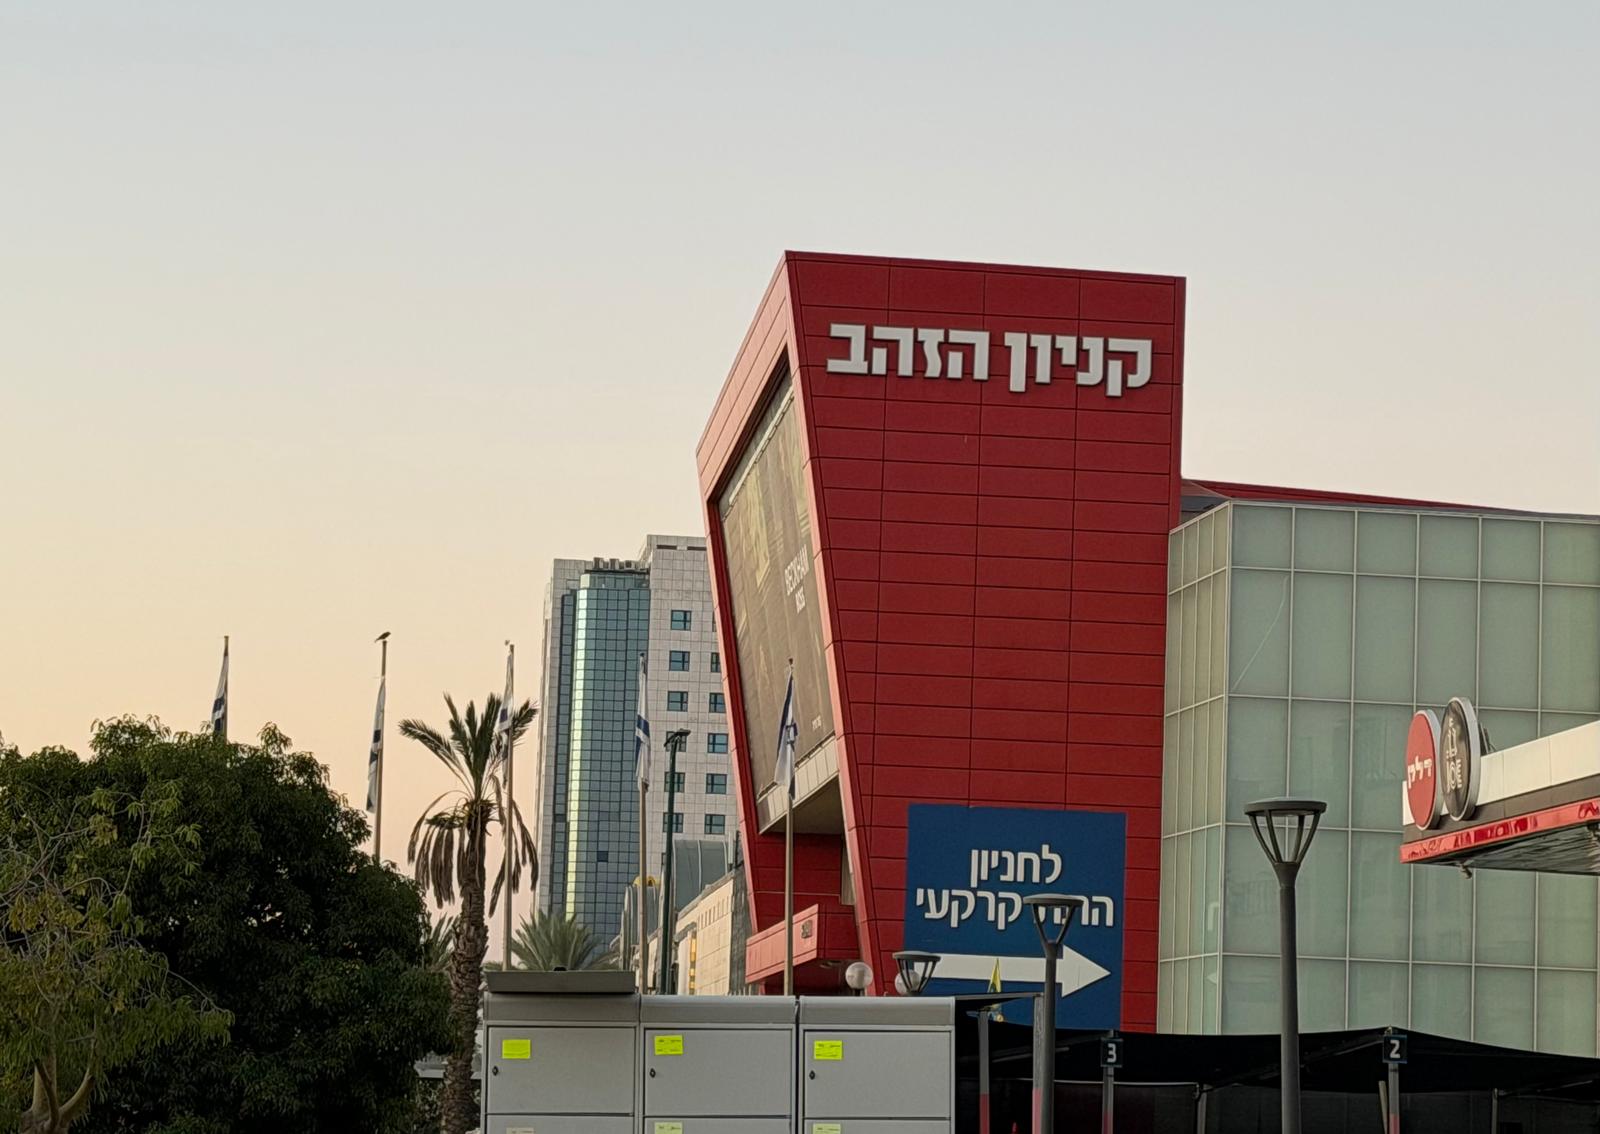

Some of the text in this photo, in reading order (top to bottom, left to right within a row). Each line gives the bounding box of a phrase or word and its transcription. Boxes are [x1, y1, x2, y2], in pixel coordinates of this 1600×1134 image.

[828, 324, 1151, 395] קניון הזהב
[1407, 755, 1432, 789] דלק
[970, 844, 1062, 888] לחניון
[916, 888, 1022, 930] קרקעי
[1107, 1044, 1116, 1062] 3
[1390, 1040, 1400, 1058] 2
